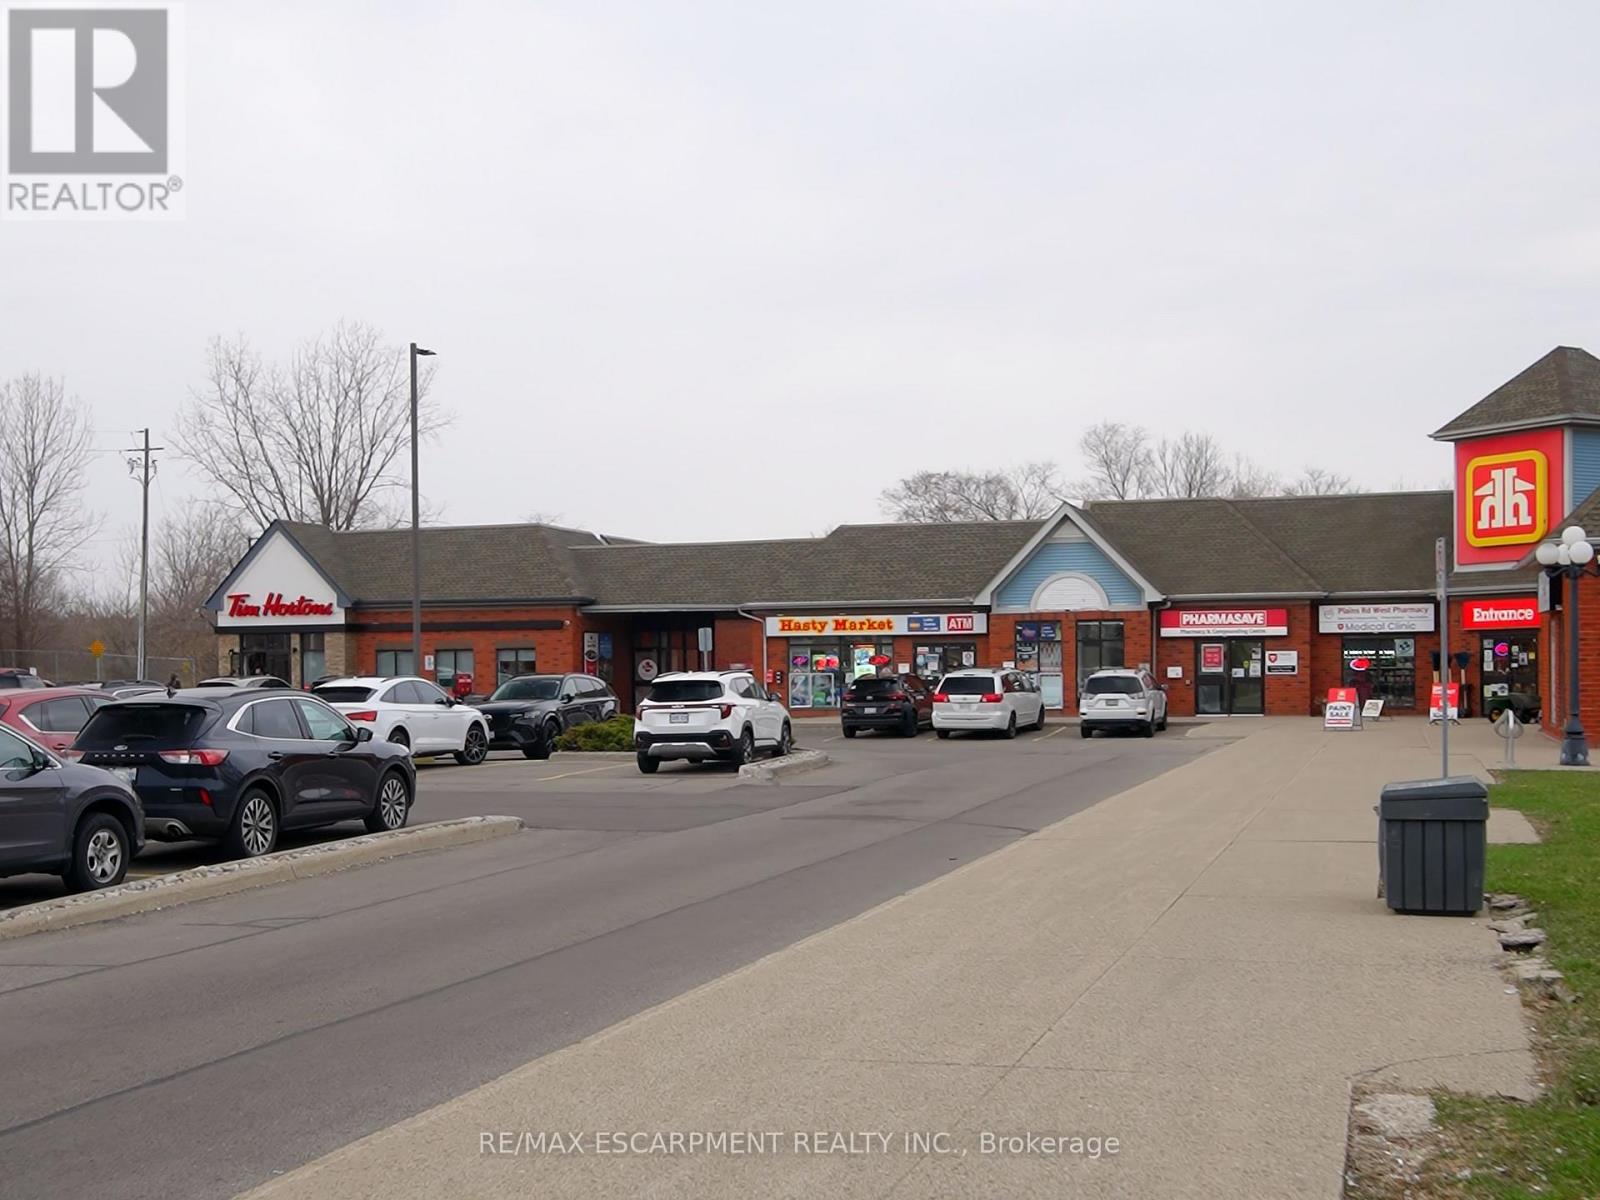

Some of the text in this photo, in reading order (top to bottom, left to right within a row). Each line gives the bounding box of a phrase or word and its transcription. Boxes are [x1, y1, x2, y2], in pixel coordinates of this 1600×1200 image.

[227, 592, 333, 617] Tim Hortons
[1373, 606, 1391, 614] West
[1393, 606, 1429, 614] Pharmacy
[1182, 613, 1264, 625] PHARMASAVE
[1473, 607, 1534, 622] Entrance
[779, 617, 894, 633] Hasty Market
[948, 616, 973, 630] ATM
[1345, 622, 1416, 631] Medical Clinic
